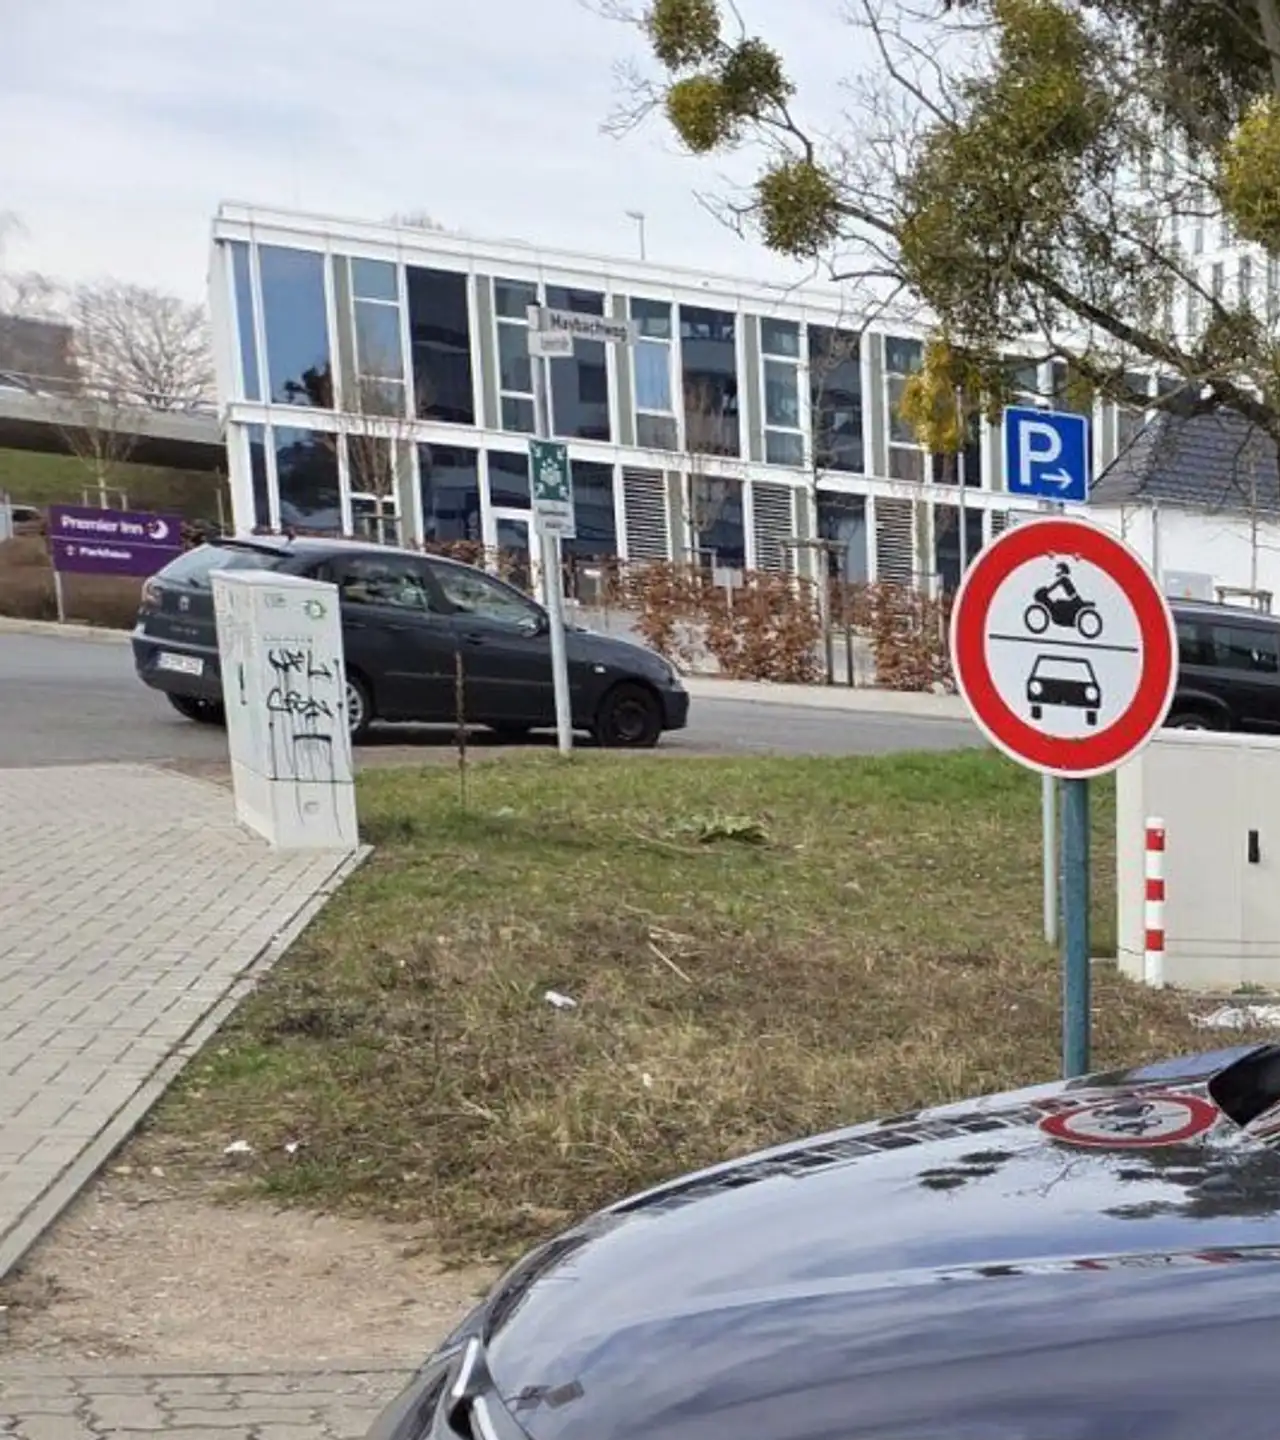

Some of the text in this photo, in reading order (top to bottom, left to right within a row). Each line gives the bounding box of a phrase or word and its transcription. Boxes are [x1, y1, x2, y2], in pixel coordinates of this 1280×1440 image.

[1018, 419, 1062, 486] P
[60, 515, 144, 535] Premier Inn
